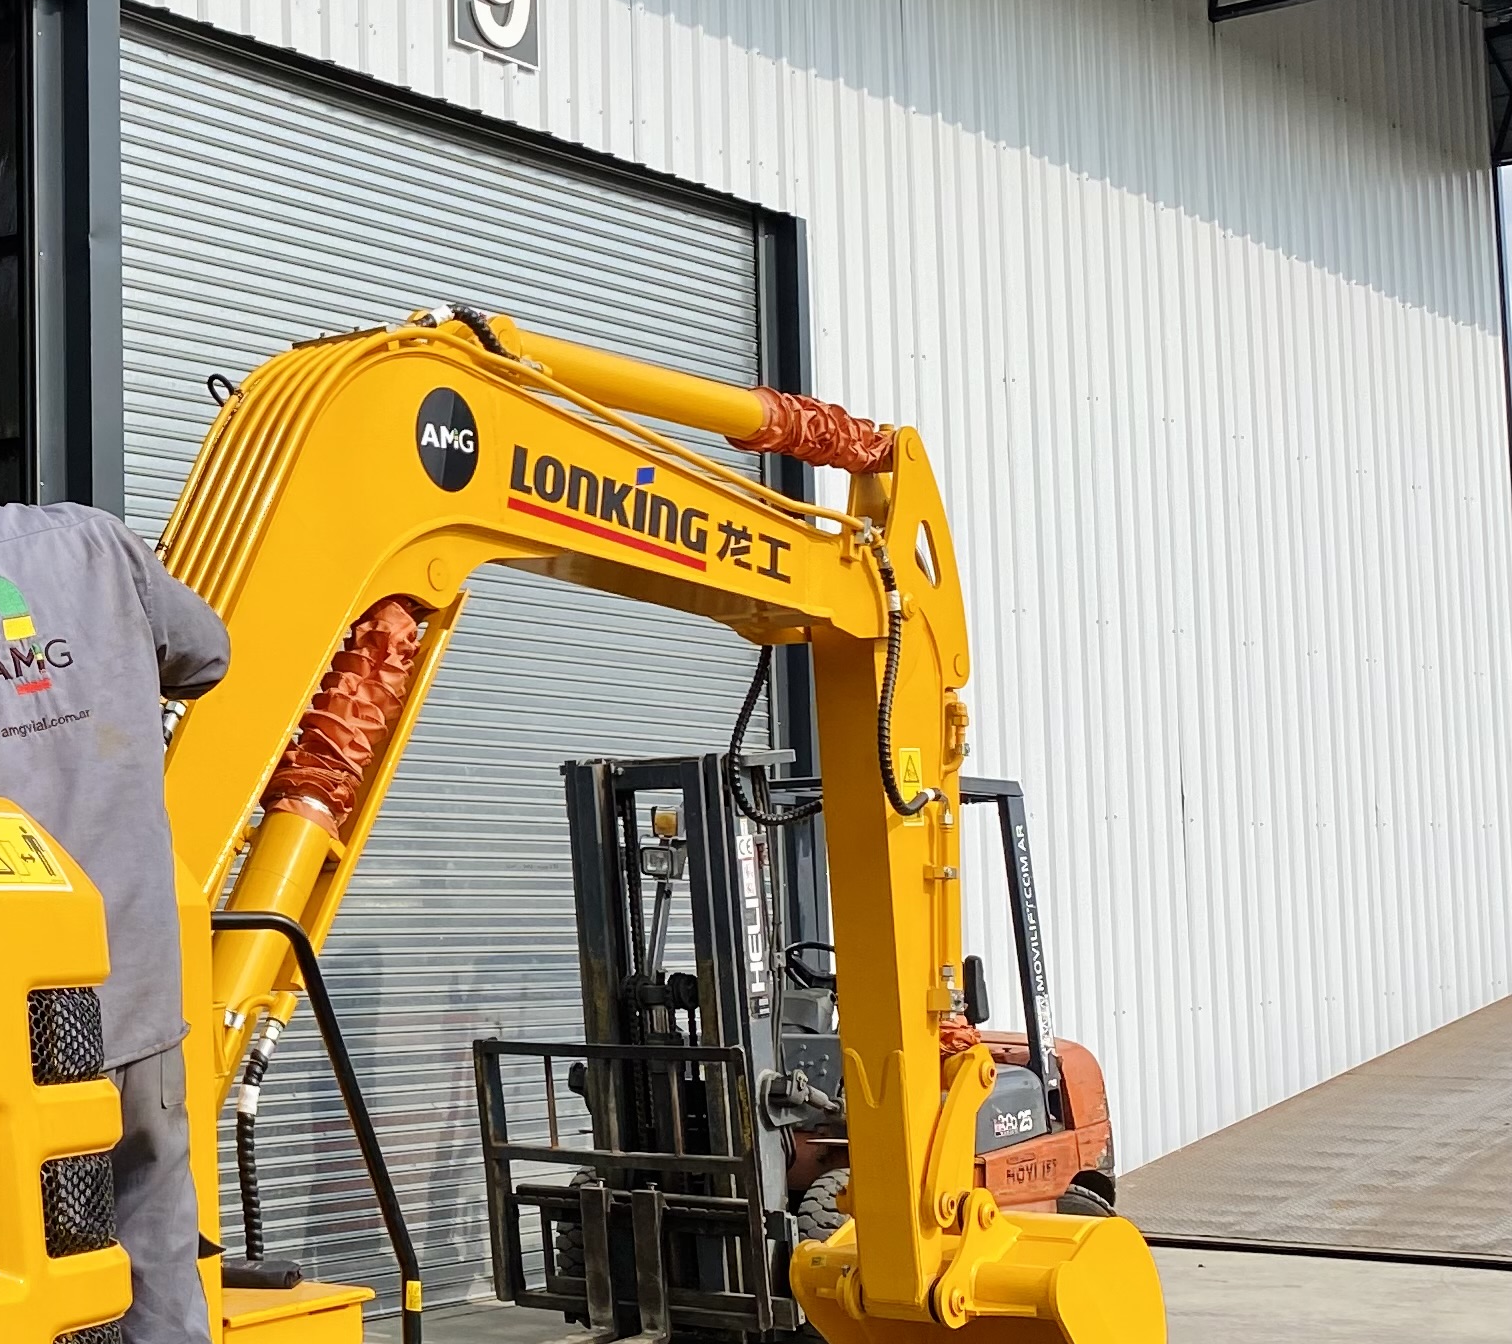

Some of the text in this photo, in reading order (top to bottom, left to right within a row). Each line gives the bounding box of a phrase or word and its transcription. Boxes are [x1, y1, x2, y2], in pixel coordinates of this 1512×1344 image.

[420, 422, 475, 453] AMG
[716, 519, 791, 584] 龙工
[0, 709, 91, 738] amgvial.com.ar
[745, 898, 766, 993] HELI
[1017, 1109, 1033, 1132] 25
